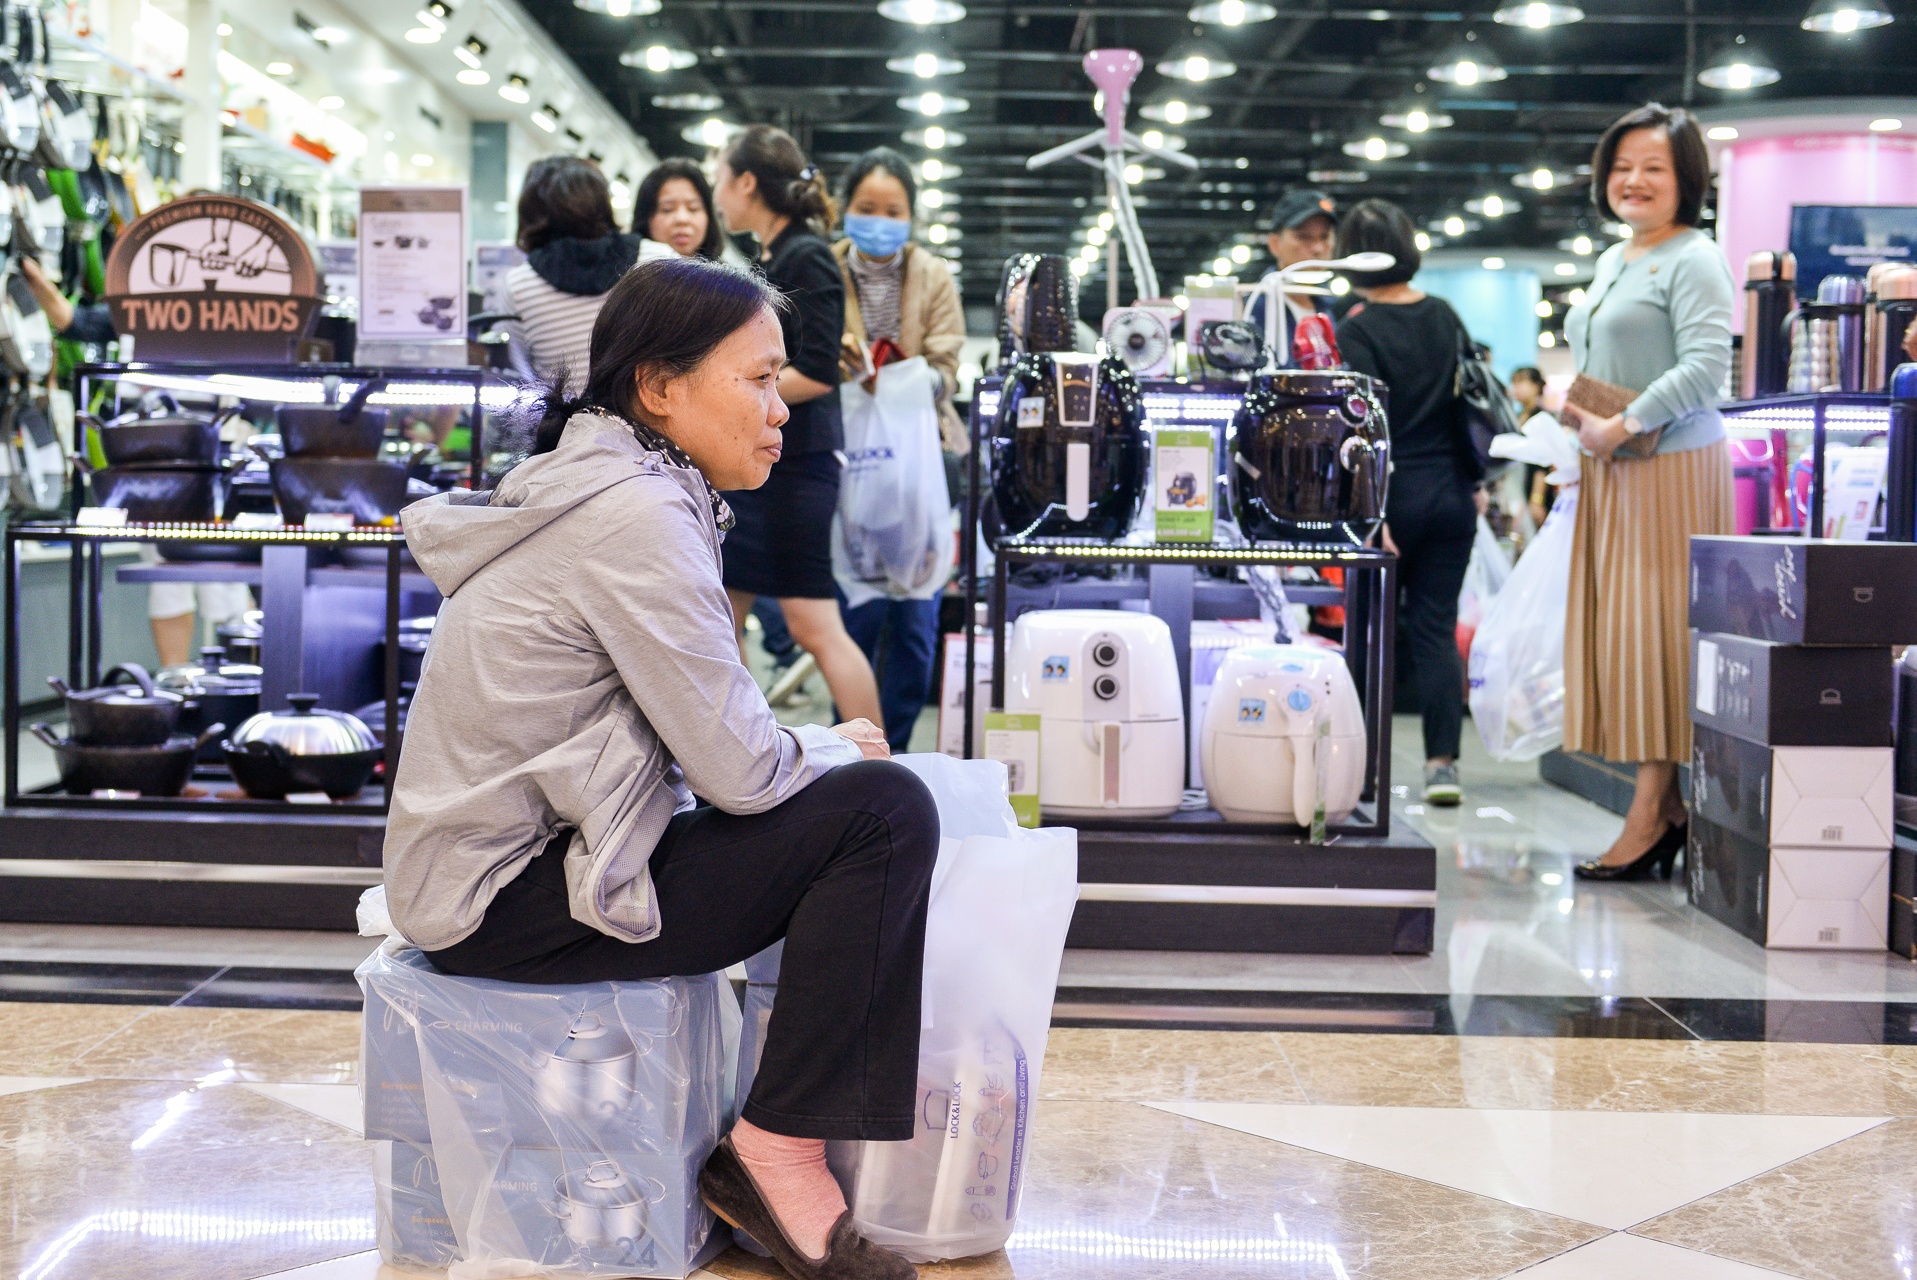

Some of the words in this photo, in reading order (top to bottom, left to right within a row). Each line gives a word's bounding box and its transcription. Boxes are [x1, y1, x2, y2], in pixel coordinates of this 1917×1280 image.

[121, 300, 193, 332] TWO
[201, 300, 299, 332] HANDS
[454, 1019, 523, 1034] CHARMING
[1017, 1060, 1027, 1080] Living
[1018, 1082, 1026, 1097] and
[950, 1081, 961, 1139] LOCK&LOCK
[1016, 1099, 1026, 1128] Kitchen
[1016, 1129, 1023, 1137] in
[1014, 1138, 1023, 1164] Leader
[491, 1180, 539, 1193] ARMING
[1010, 1166, 1020, 1190] Global
[616, 1236, 657, 1268] 24
